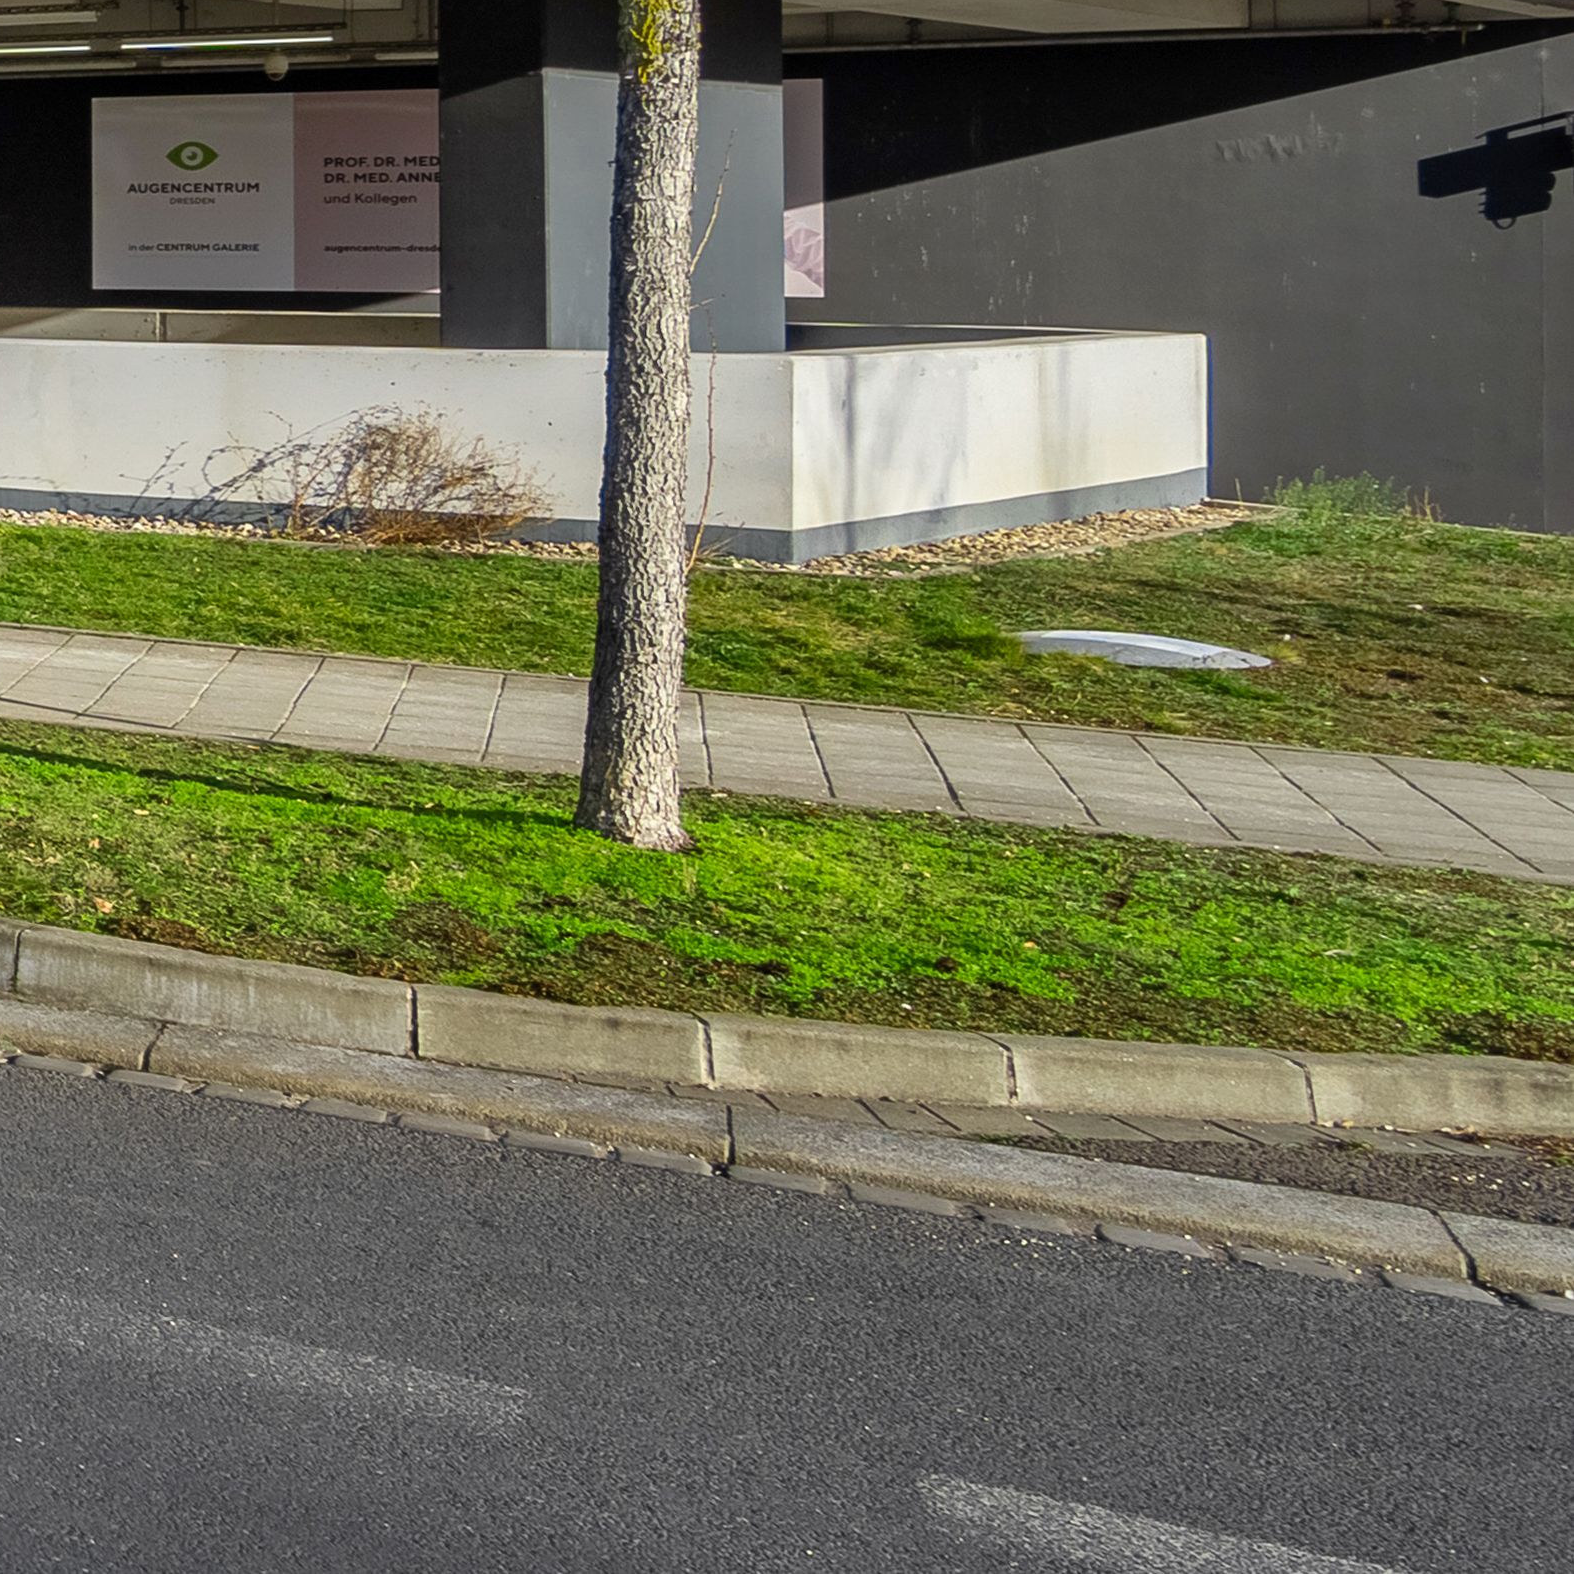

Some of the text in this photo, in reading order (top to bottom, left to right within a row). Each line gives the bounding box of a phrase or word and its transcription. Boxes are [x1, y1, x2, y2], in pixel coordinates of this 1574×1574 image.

[324, 157, 370, 168] PROF.
[374, 156, 400, 167] DR.
[324, 173, 350, 183] DR.
[354, 172, 393, 183] MED.
[127, 182, 260, 194] AUGENCENTRUM
[169, 197, 216, 205] DRESDEN
[324, 193, 417, 206] und Kollegen
[139, 243, 154, 251] der
[156, 243, 210, 252] CENTRUM
[212, 243, 260, 252] GALERIE
